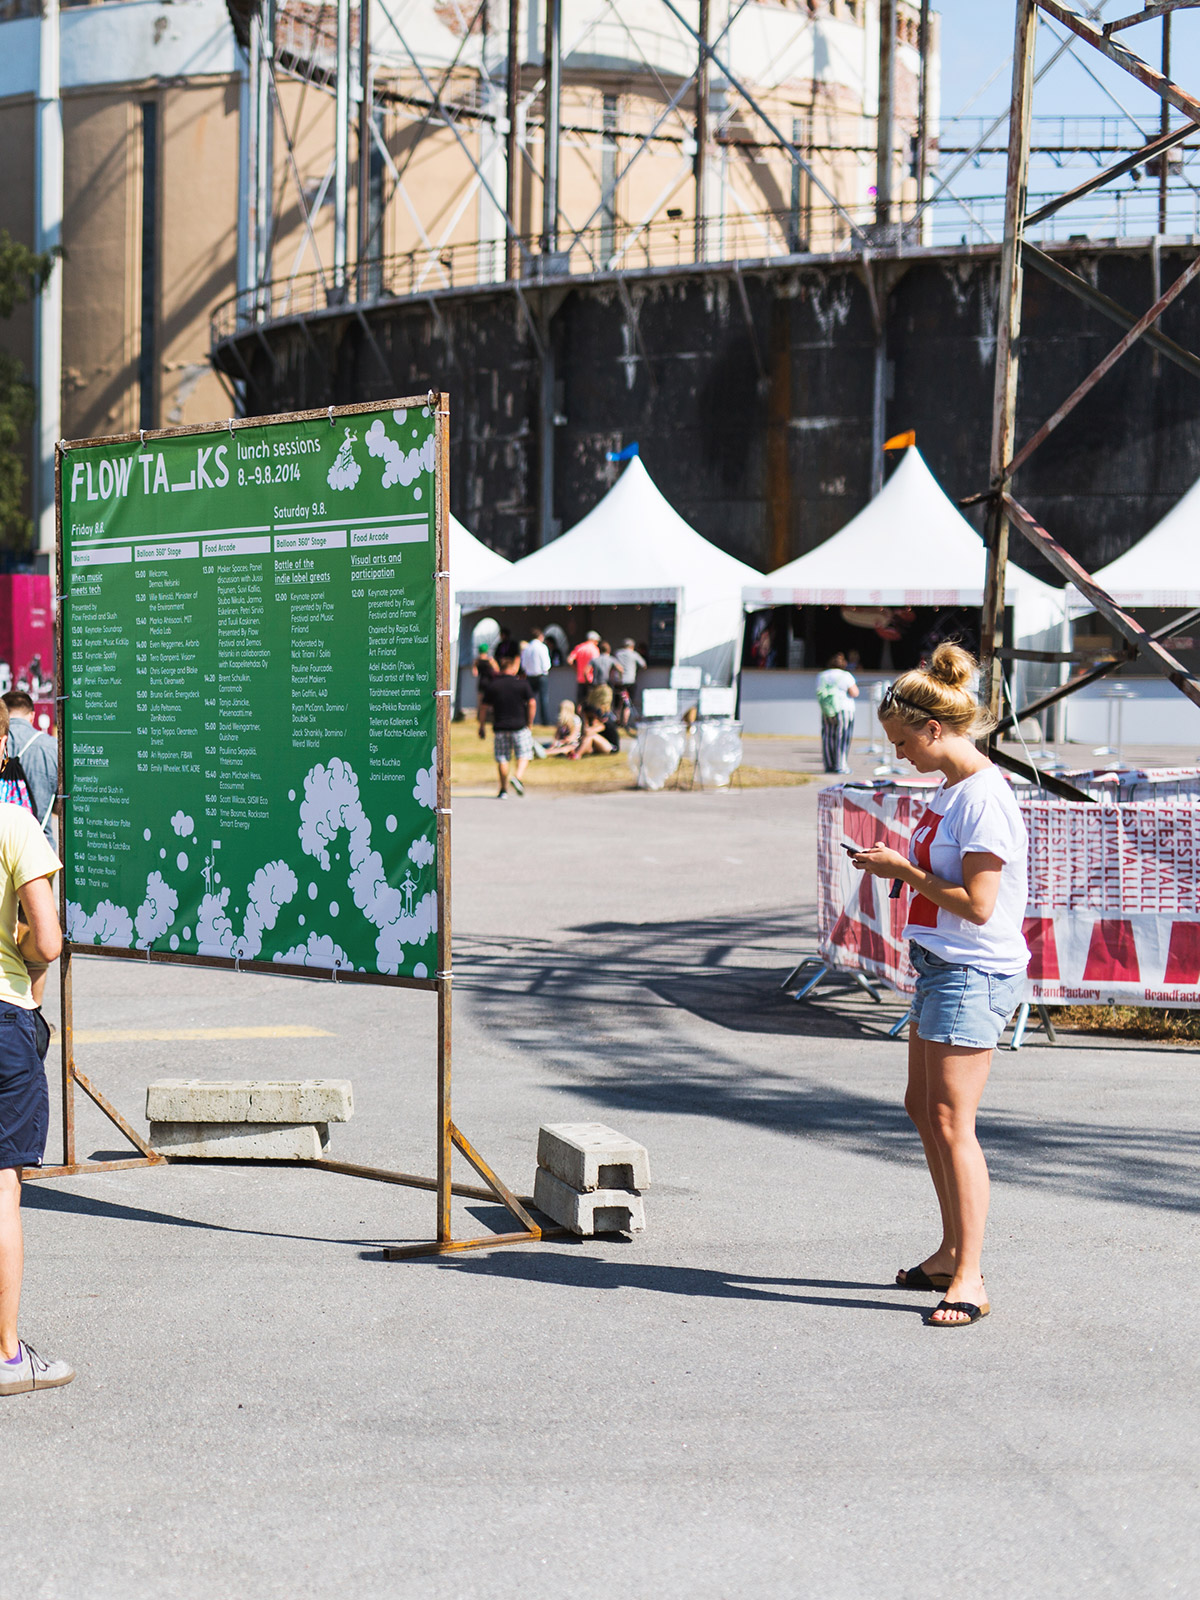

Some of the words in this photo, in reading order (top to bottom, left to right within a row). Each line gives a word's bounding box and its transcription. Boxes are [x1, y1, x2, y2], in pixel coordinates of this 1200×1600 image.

[237, 440, 270, 460] lunch
[273, 436, 321, 457] sessions
[71, 456, 133, 502] FLOW
[273, 504, 310, 519] Saturday
[312, 502, 327, 516] 9.8.
[71, 523, 93, 536] Friday
[276, 539, 296, 548] Balloon
[311, 536, 326, 546] Stage
[353, 533, 368, 542] Food
[369, 532, 389, 540] Arcade
[136, 550, 154, 558] Balloon
[168, 547, 181, 556] Stage
[204, 544, 218, 553] Food
[218, 543, 236, 552] Arcade
[274, 559, 293, 569] Battle
[294, 558, 302, 568] of
[303, 558, 314, 568] the
[350, 554, 371, 565] Visual
[372, 554, 386, 563] arts
[387, 551, 402, 562] and
[274, 573, 290, 583] indie
[291, 572, 308, 582] label
[309, 572, 330, 583] greats
[350, 568, 395, 581] participation
[309, 613, 319, 622] and
[388, 610, 399, 618] and
[388, 635, 395, 644] of
[413, 635, 428, 643] Visual
[368, 673, 383, 682] Visual
[398, 673, 404, 681] of
[404, 673, 414, 681] the
[1033, 985, 1100, 1001] BrandFactory
